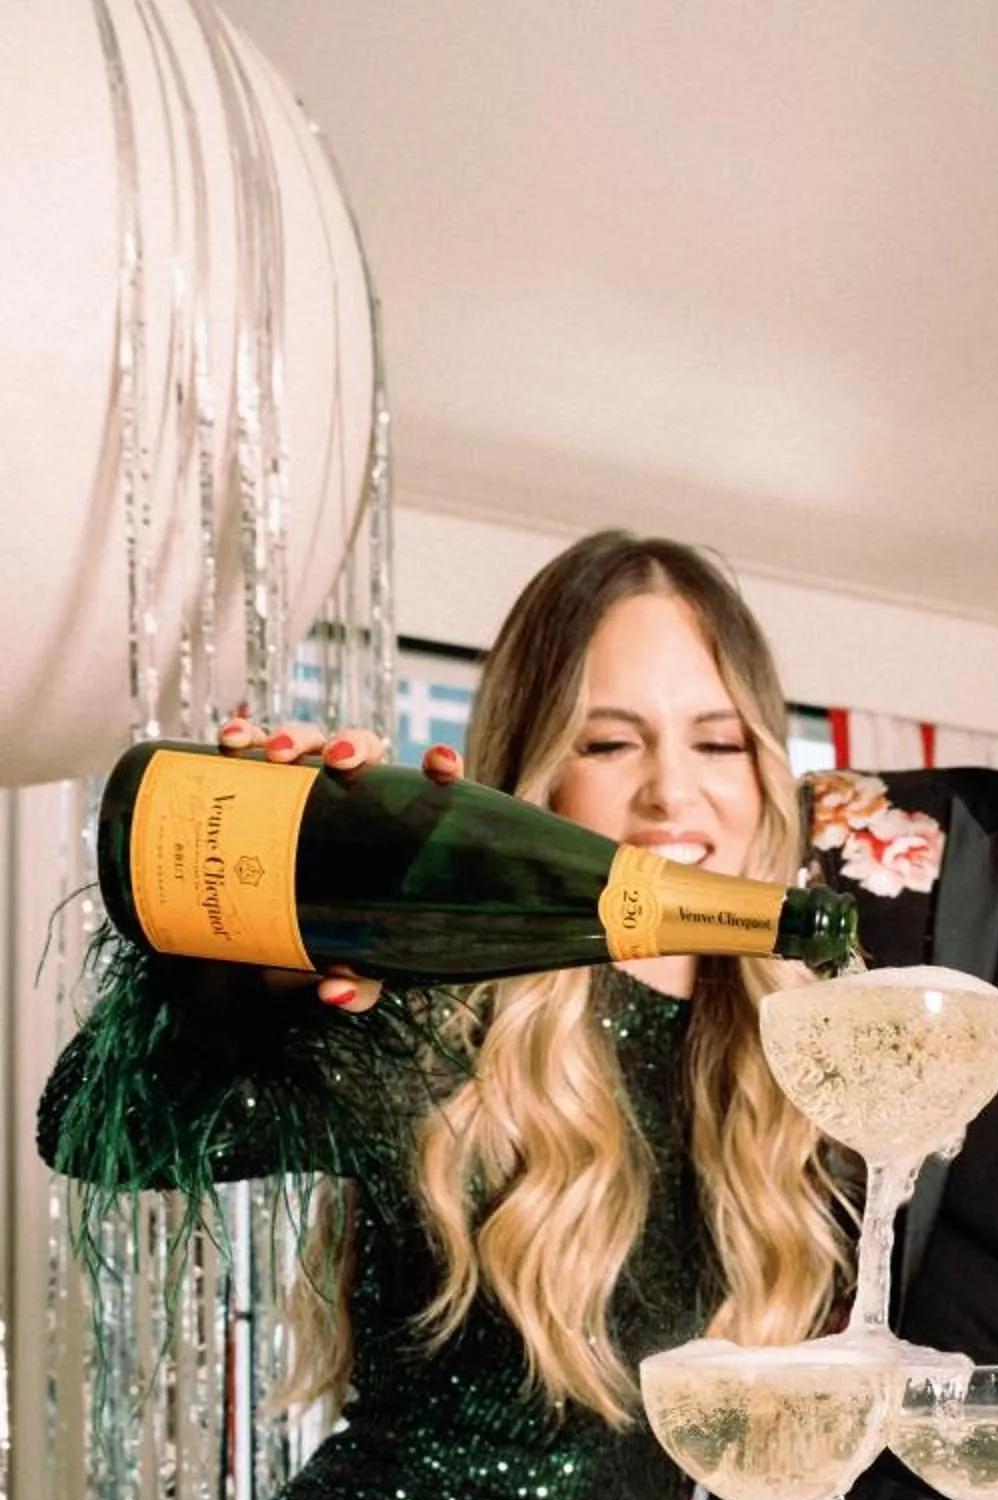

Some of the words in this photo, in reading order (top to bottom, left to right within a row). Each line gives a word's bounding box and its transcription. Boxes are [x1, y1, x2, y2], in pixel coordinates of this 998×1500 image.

[207, 793, 236, 852] Veuve
[173, 842, 185, 880] BRUT
[202, 856, 229, 937] Clicquot
[679, 906, 715, 924] Veuve
[717, 911, 771, 931] Clicquot
